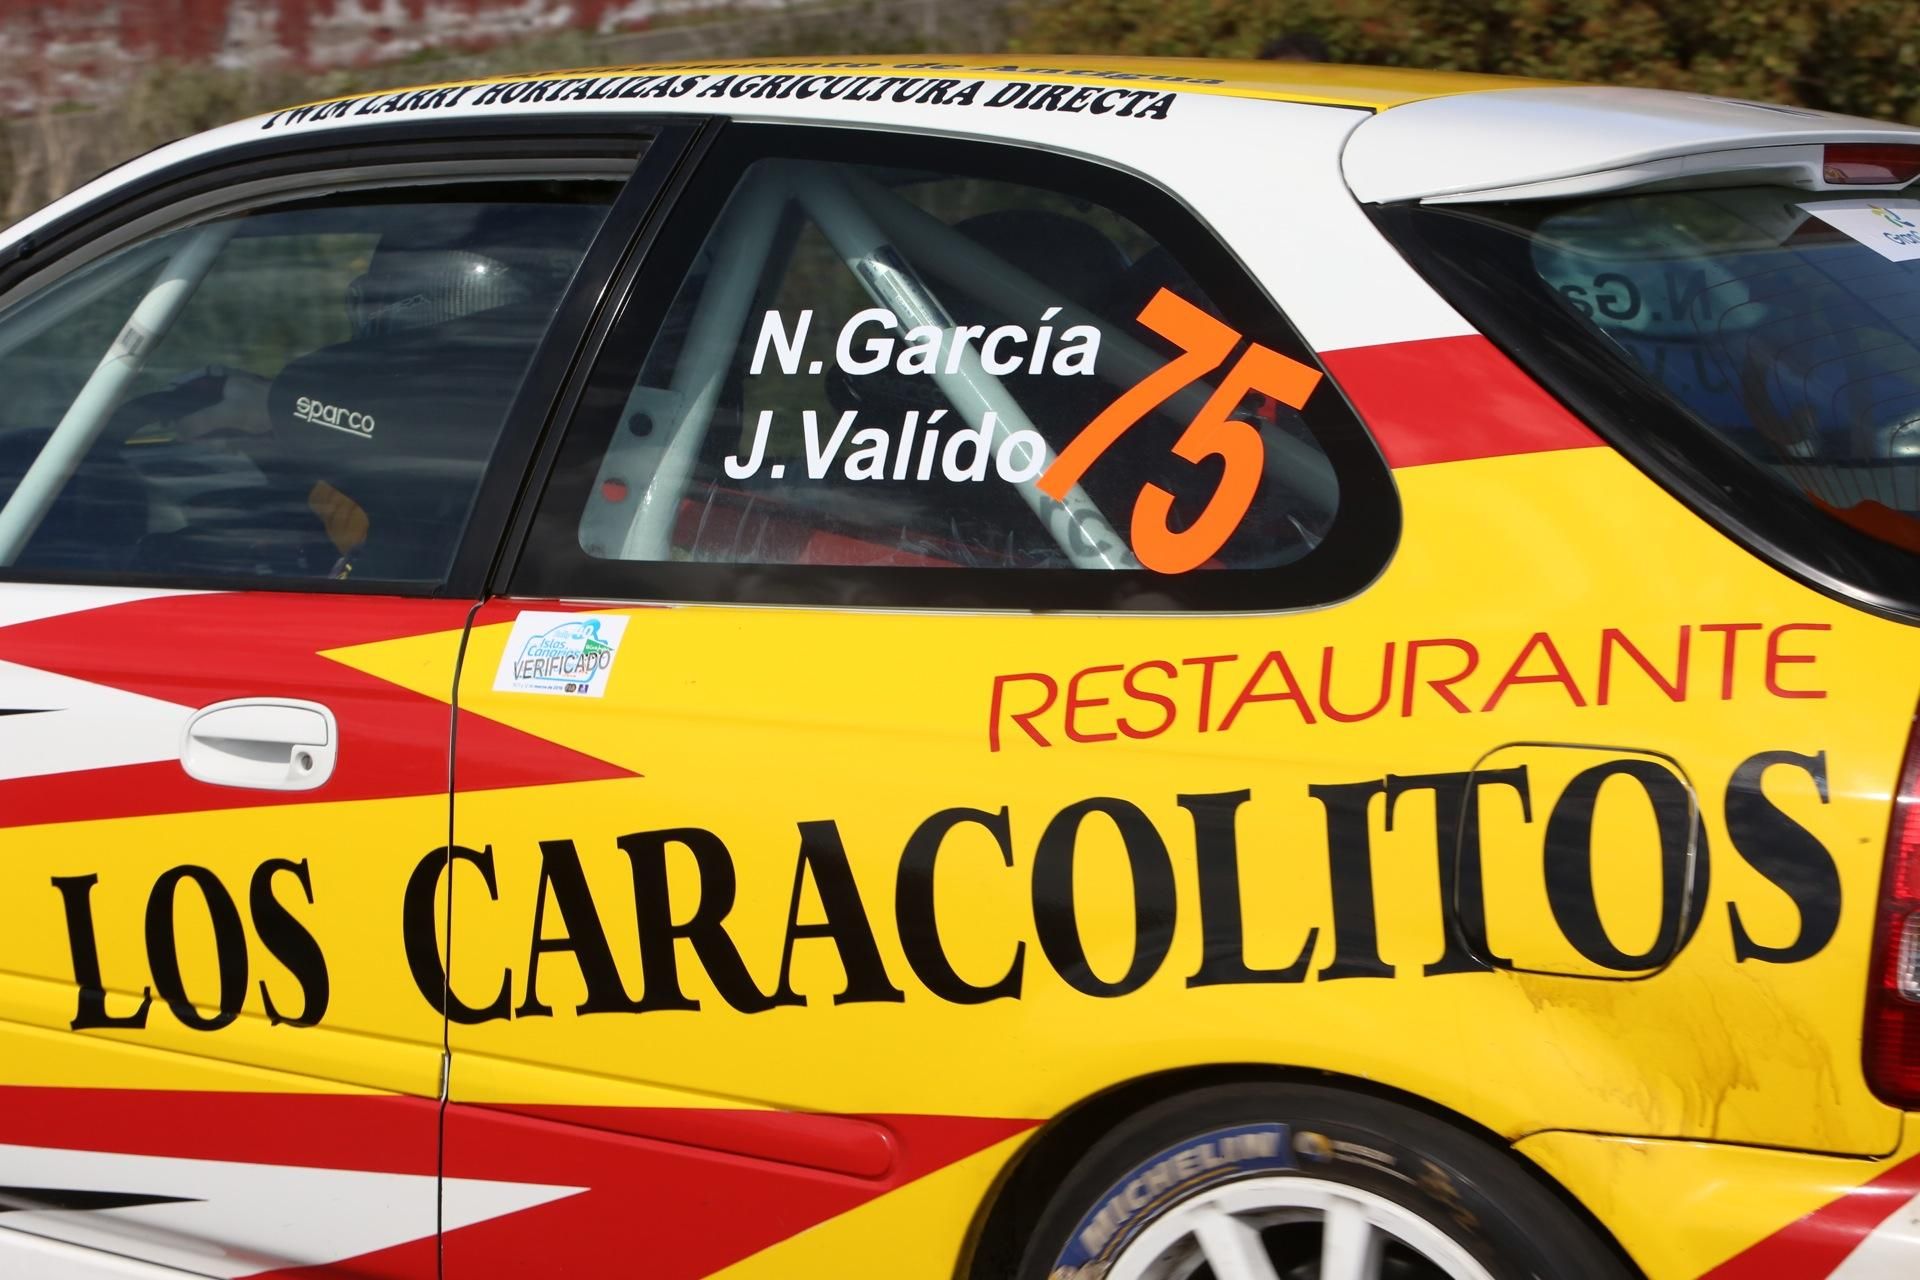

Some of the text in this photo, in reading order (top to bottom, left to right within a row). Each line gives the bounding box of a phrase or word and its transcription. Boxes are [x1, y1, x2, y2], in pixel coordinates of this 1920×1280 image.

[353, 84, 488, 116] LARRY
[472, 74, 711, 106] HORTALIZAS
[695, 74, 986, 106] AGRICULTURA
[983, 81, 1178, 120] DIRECTA
[748, 306, 1102, 377] N.García
[296, 396, 376, 434] sparco
[723, 409, 1047, 484] J.Valído
[1035, 286, 1323, 575] 75
[513, 650, 611, 681] VERIFICADO
[540, 637, 567, 650] Islas
[989, 622, 1832, 753] RESTAURANTE
[50, 749, 1842, 1032] LOS CARACOLITOS
[1081, 1131, 1282, 1257] MICHELIN
